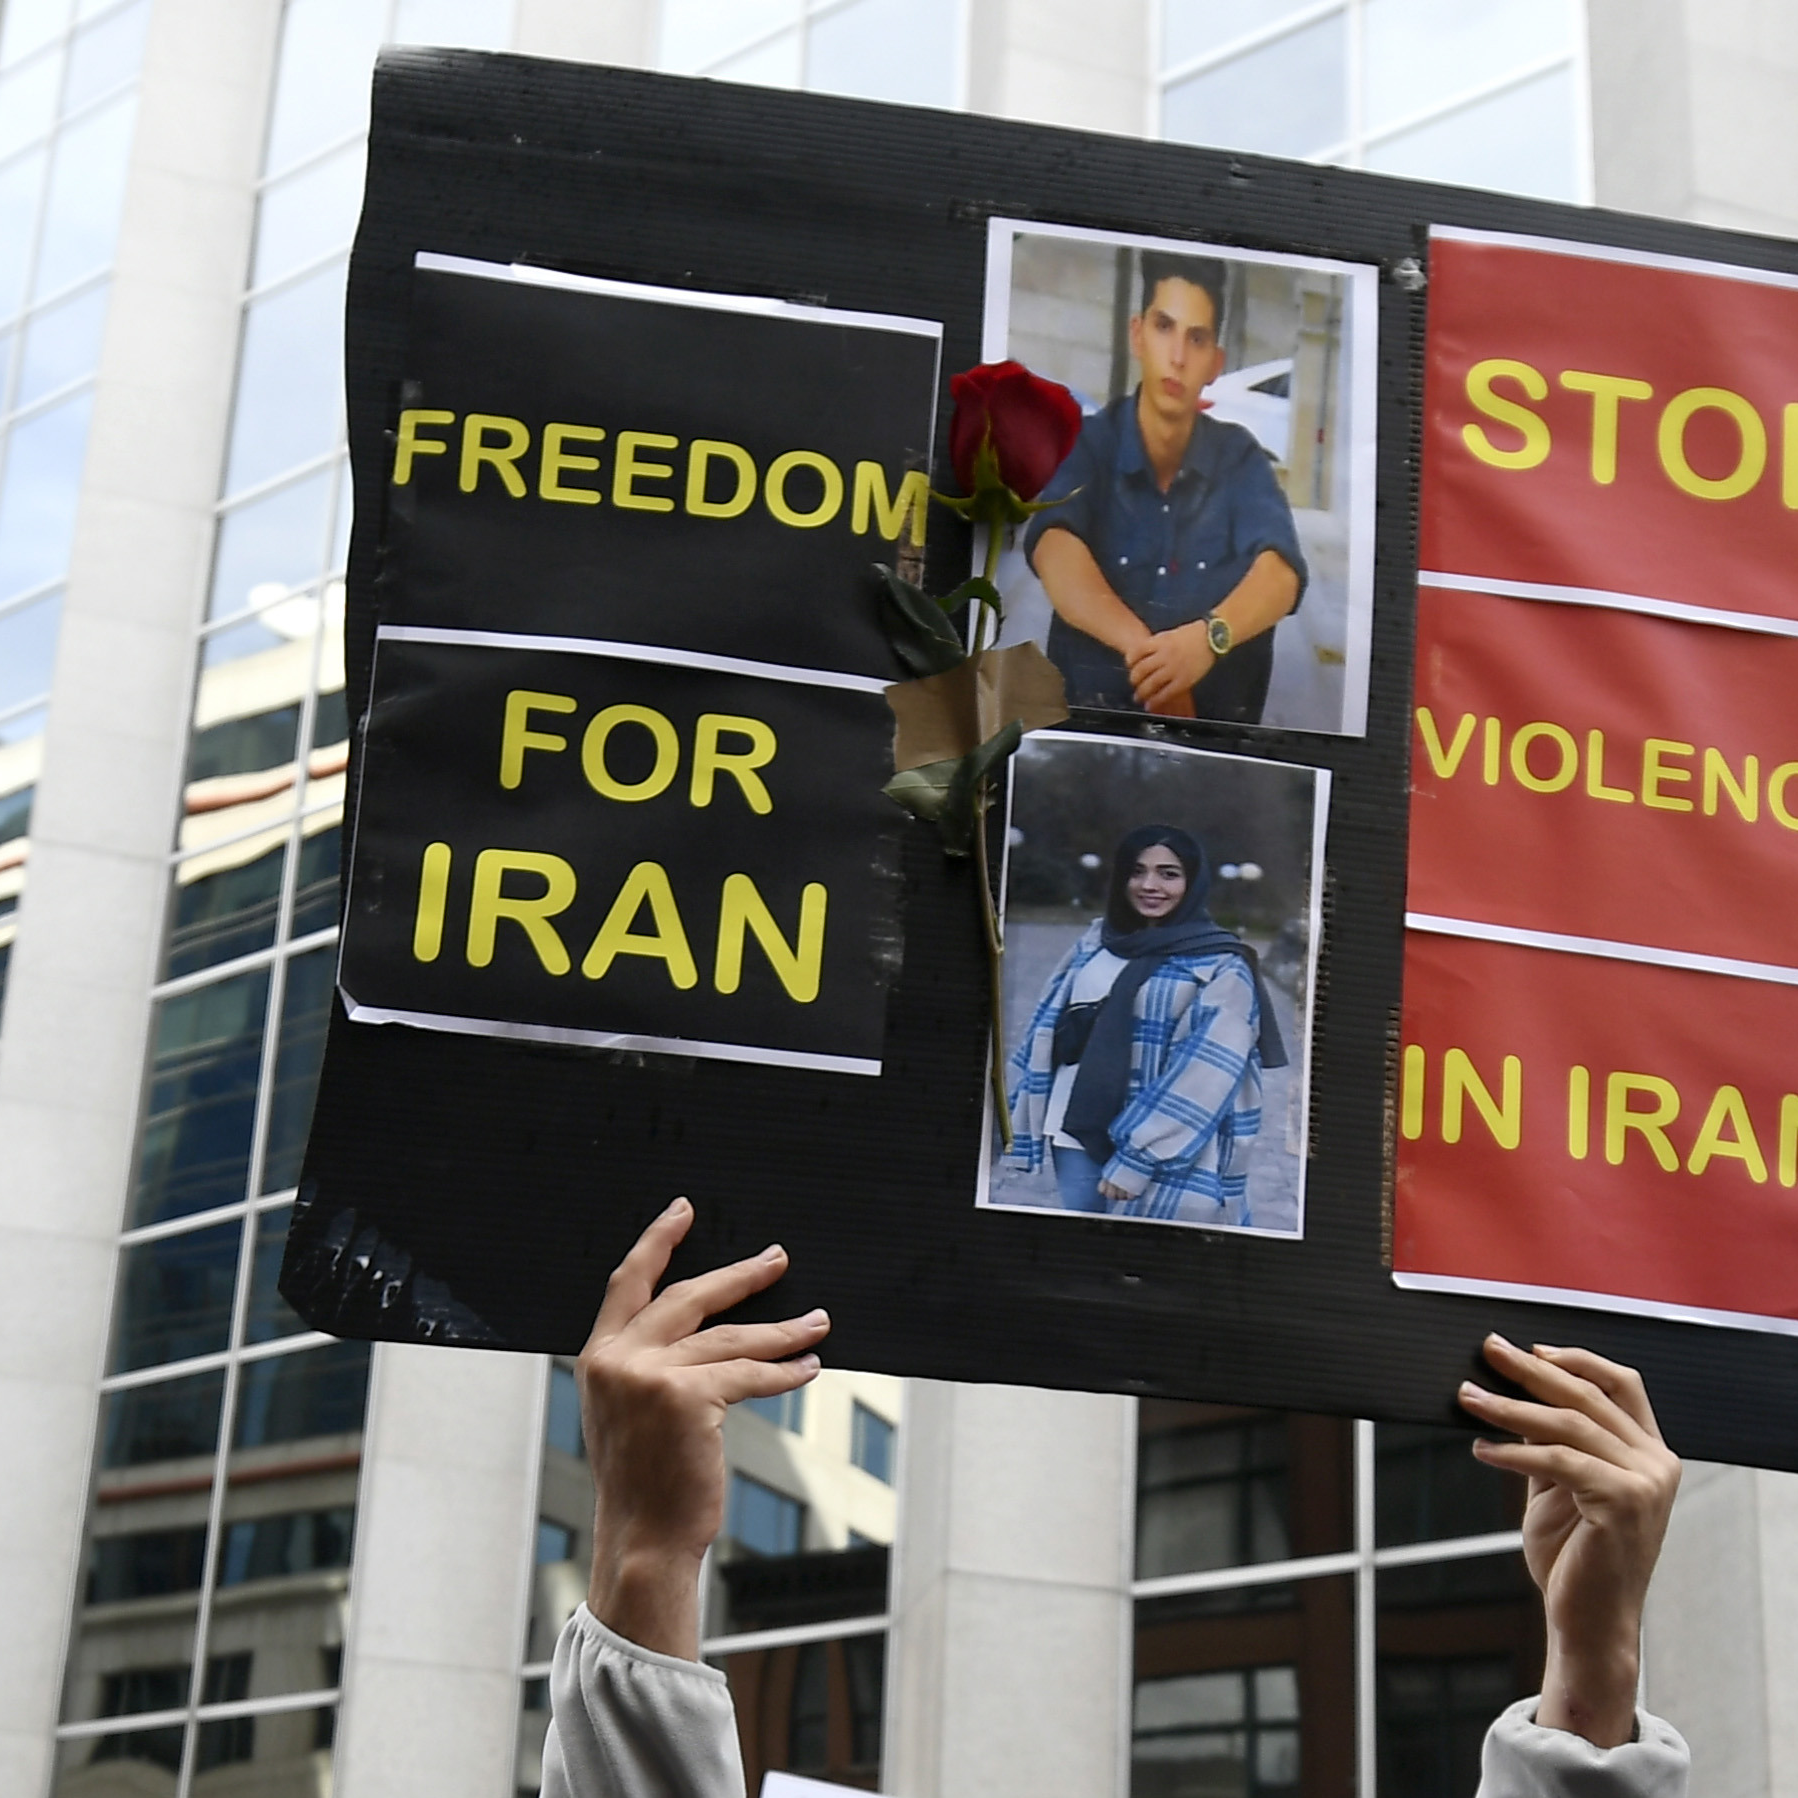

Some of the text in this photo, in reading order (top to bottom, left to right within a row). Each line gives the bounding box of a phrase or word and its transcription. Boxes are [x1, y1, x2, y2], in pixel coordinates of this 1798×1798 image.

[391, 408, 930, 548] FREEDOM
[498, 688, 779, 815] FOR
[412, 841, 829, 1003] IRAN
[1402, 1043, 1522, 1150] IN
